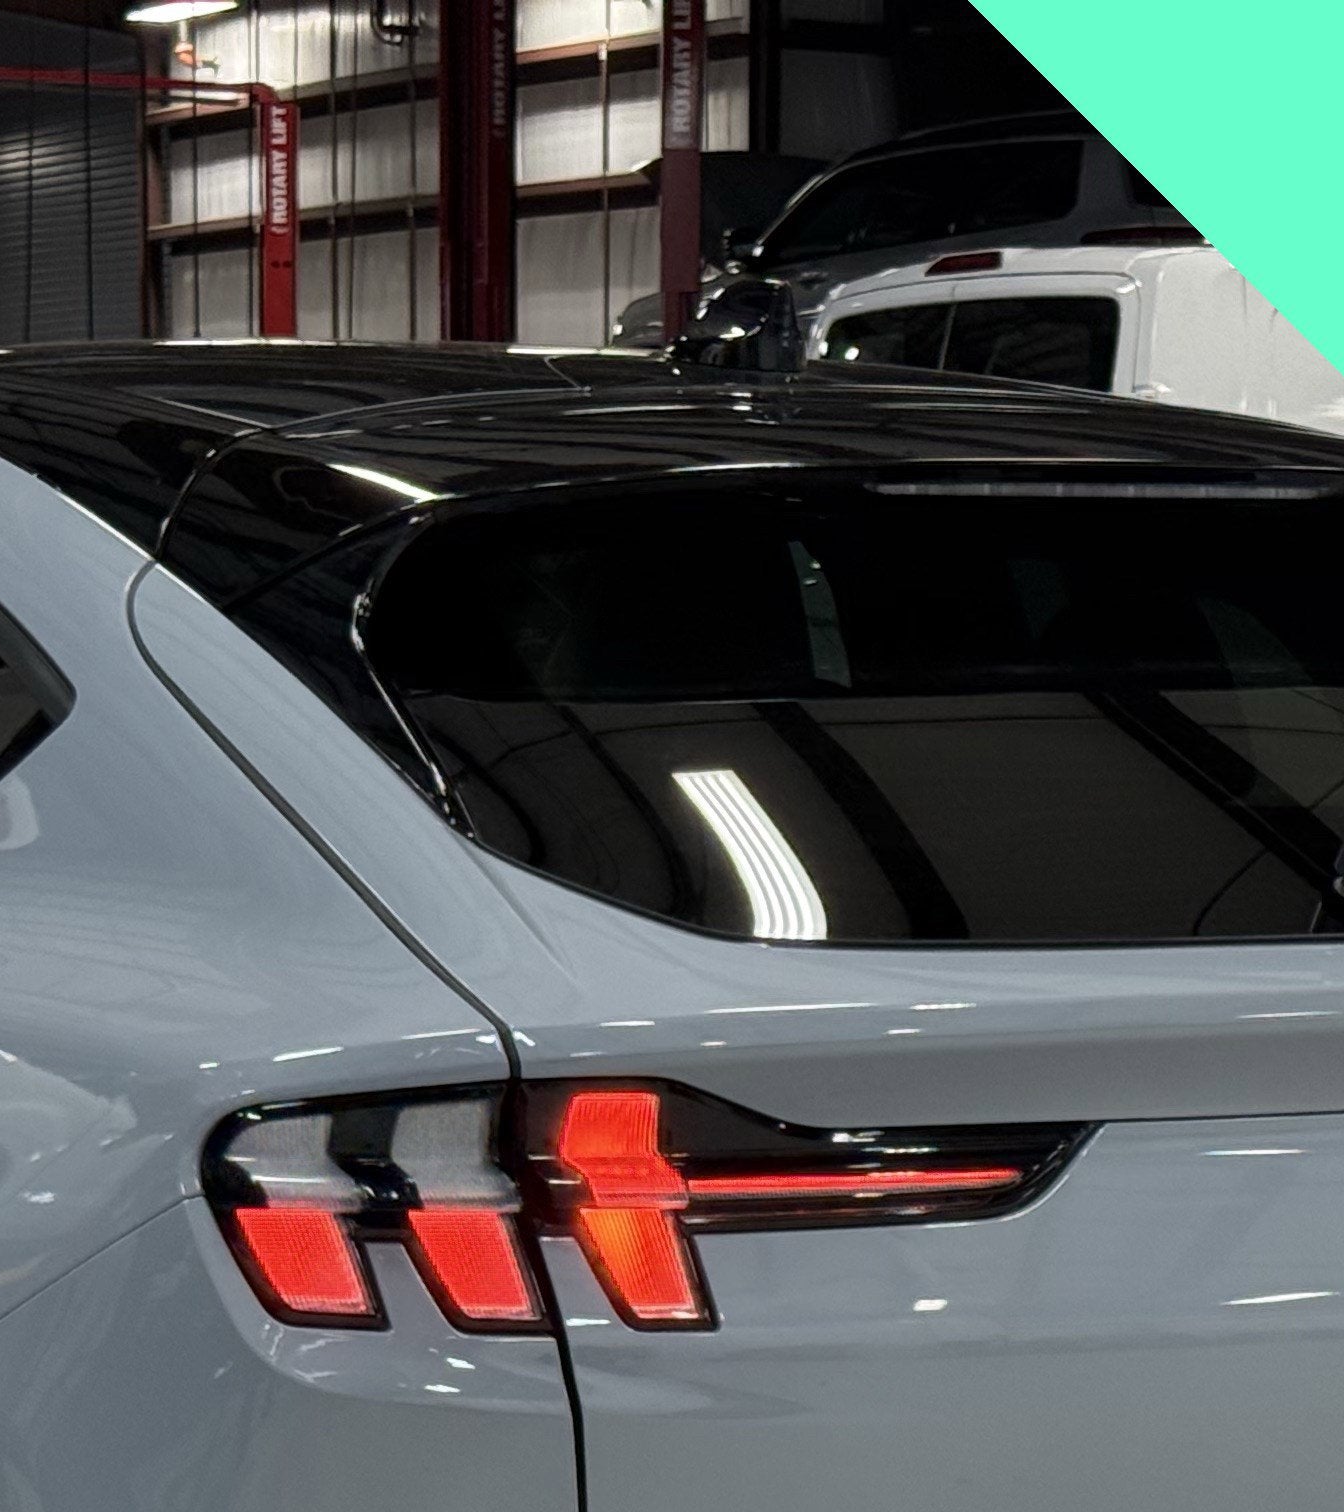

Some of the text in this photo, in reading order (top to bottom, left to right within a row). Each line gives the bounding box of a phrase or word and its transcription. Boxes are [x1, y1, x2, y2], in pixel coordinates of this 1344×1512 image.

[672, 35, 691, 132] ROTARY
[271, 106, 288, 224] ROTARY LIFT
